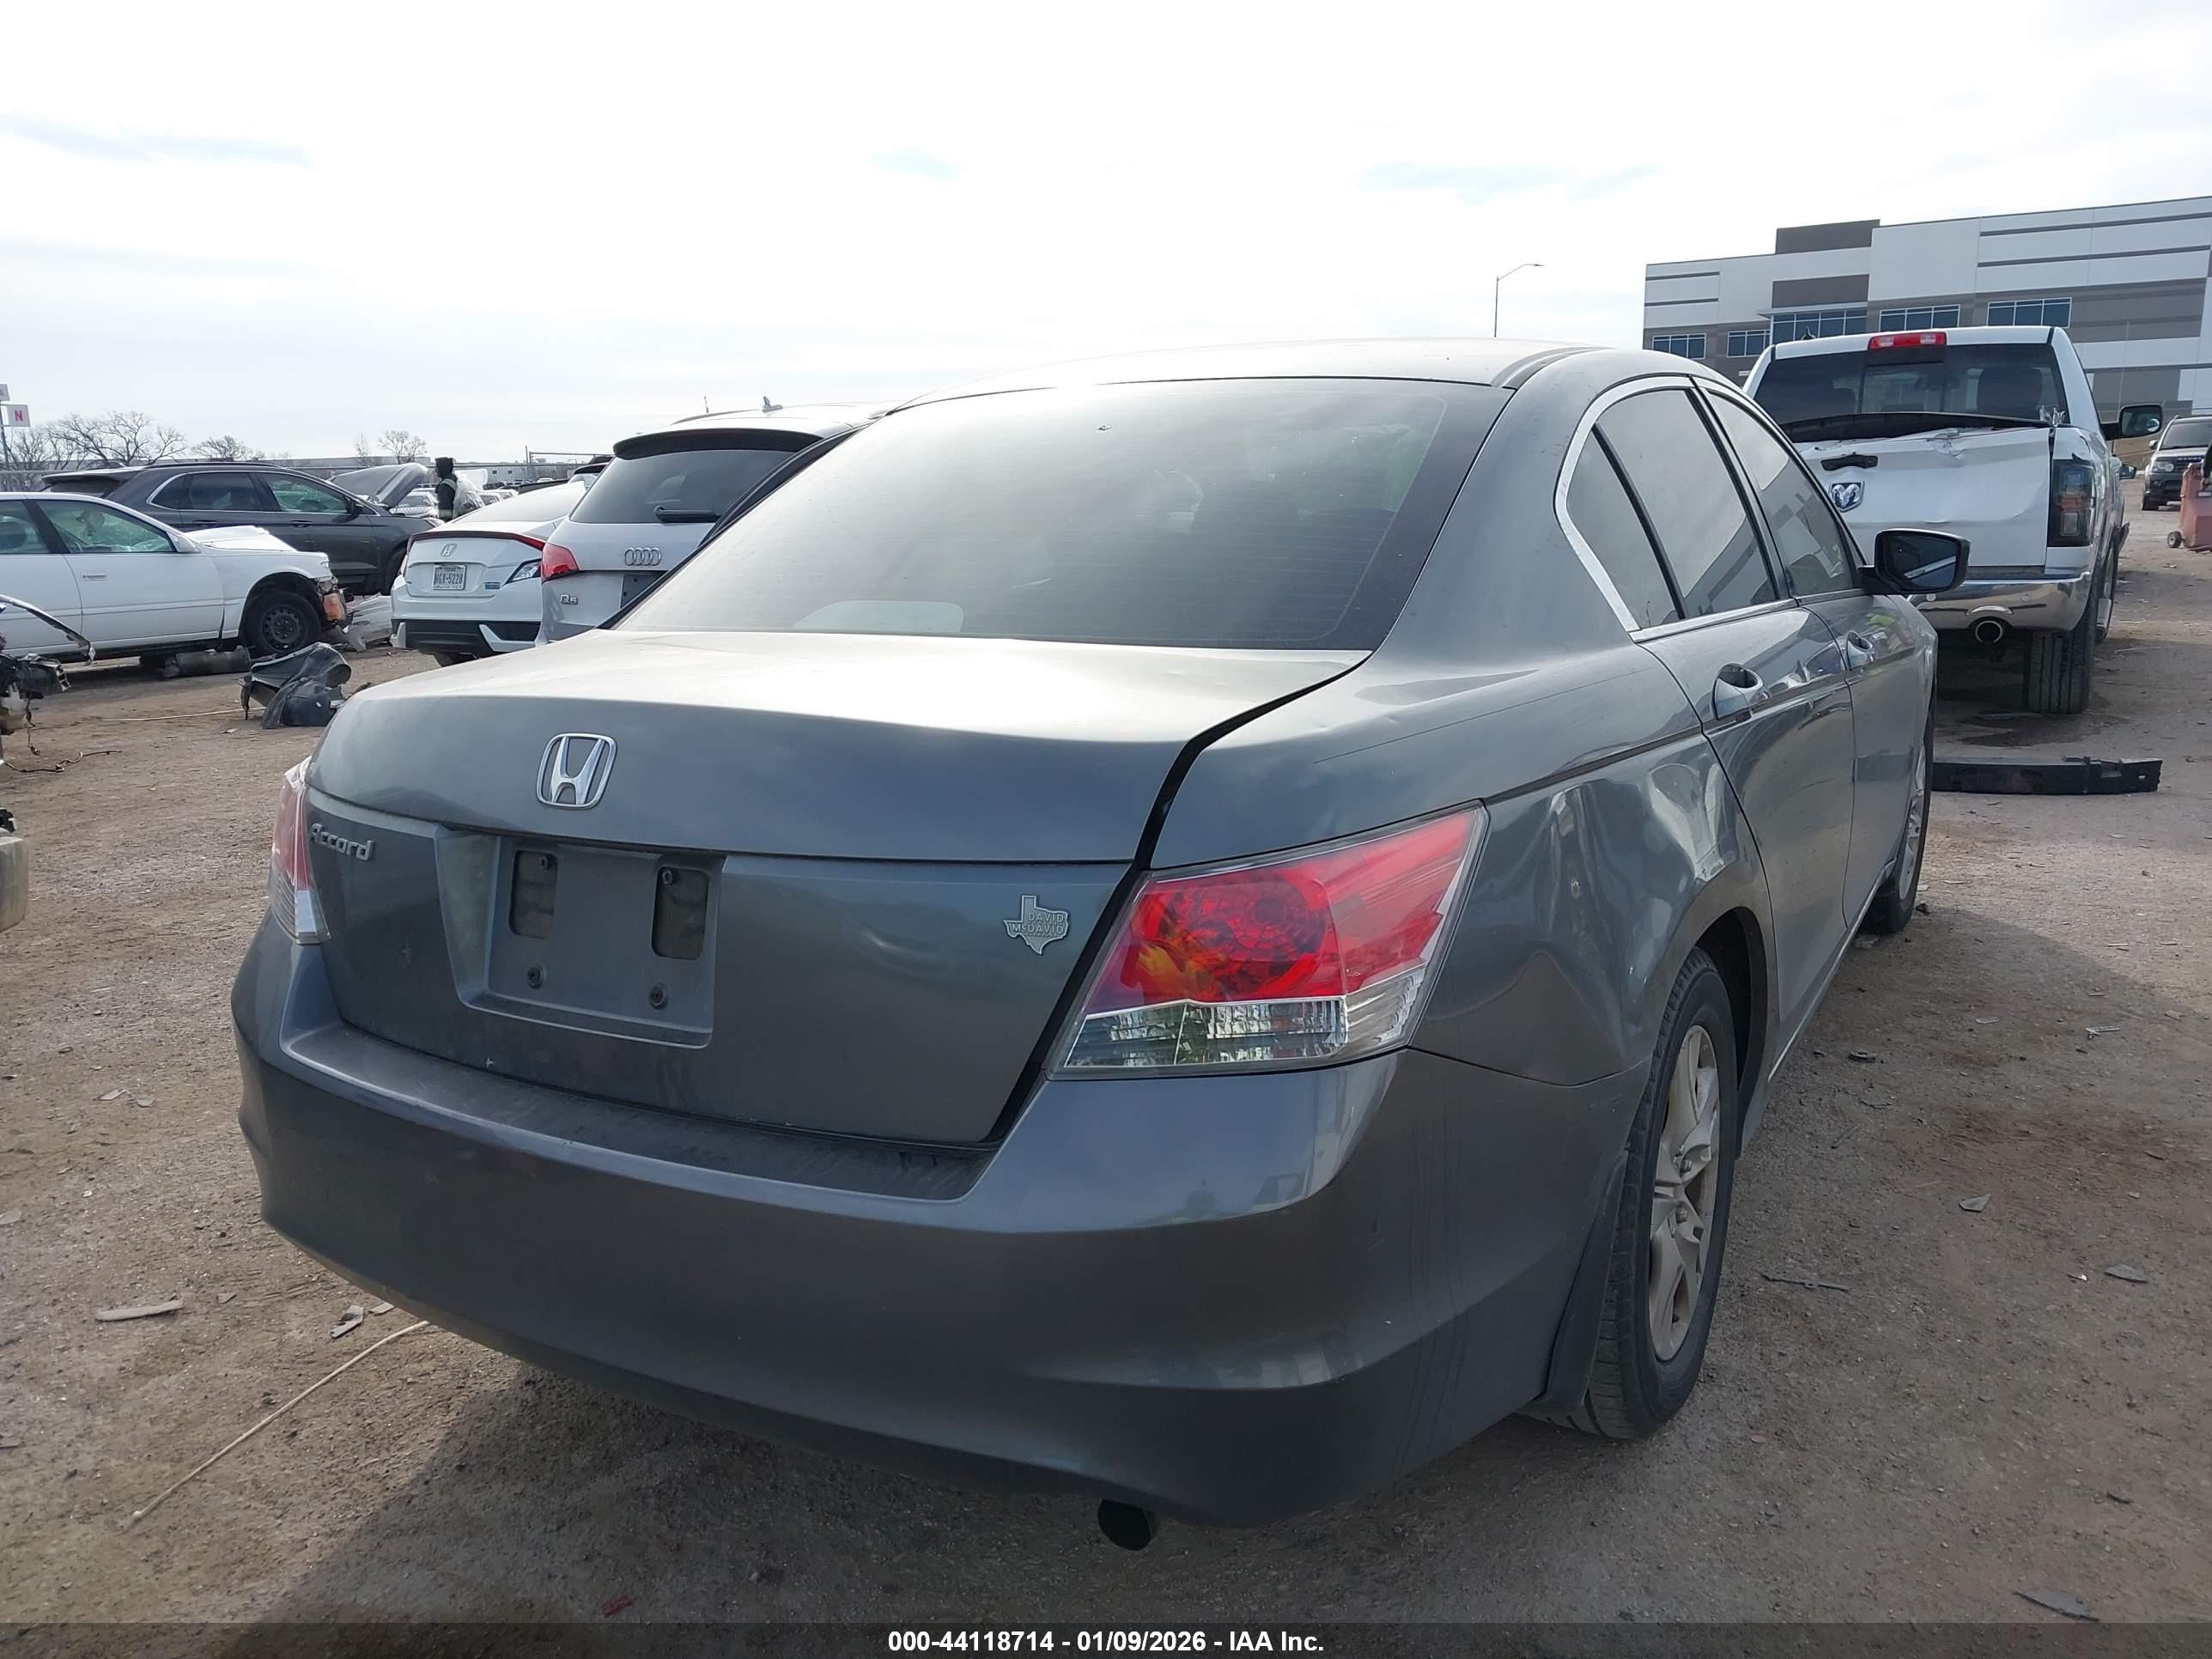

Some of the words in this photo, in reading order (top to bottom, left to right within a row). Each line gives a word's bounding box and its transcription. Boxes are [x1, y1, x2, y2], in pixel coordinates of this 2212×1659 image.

[14, 410, 24, 422] N
[310, 823, 374, 860] Accord
[1028, 913, 1065, 923] DAVID
